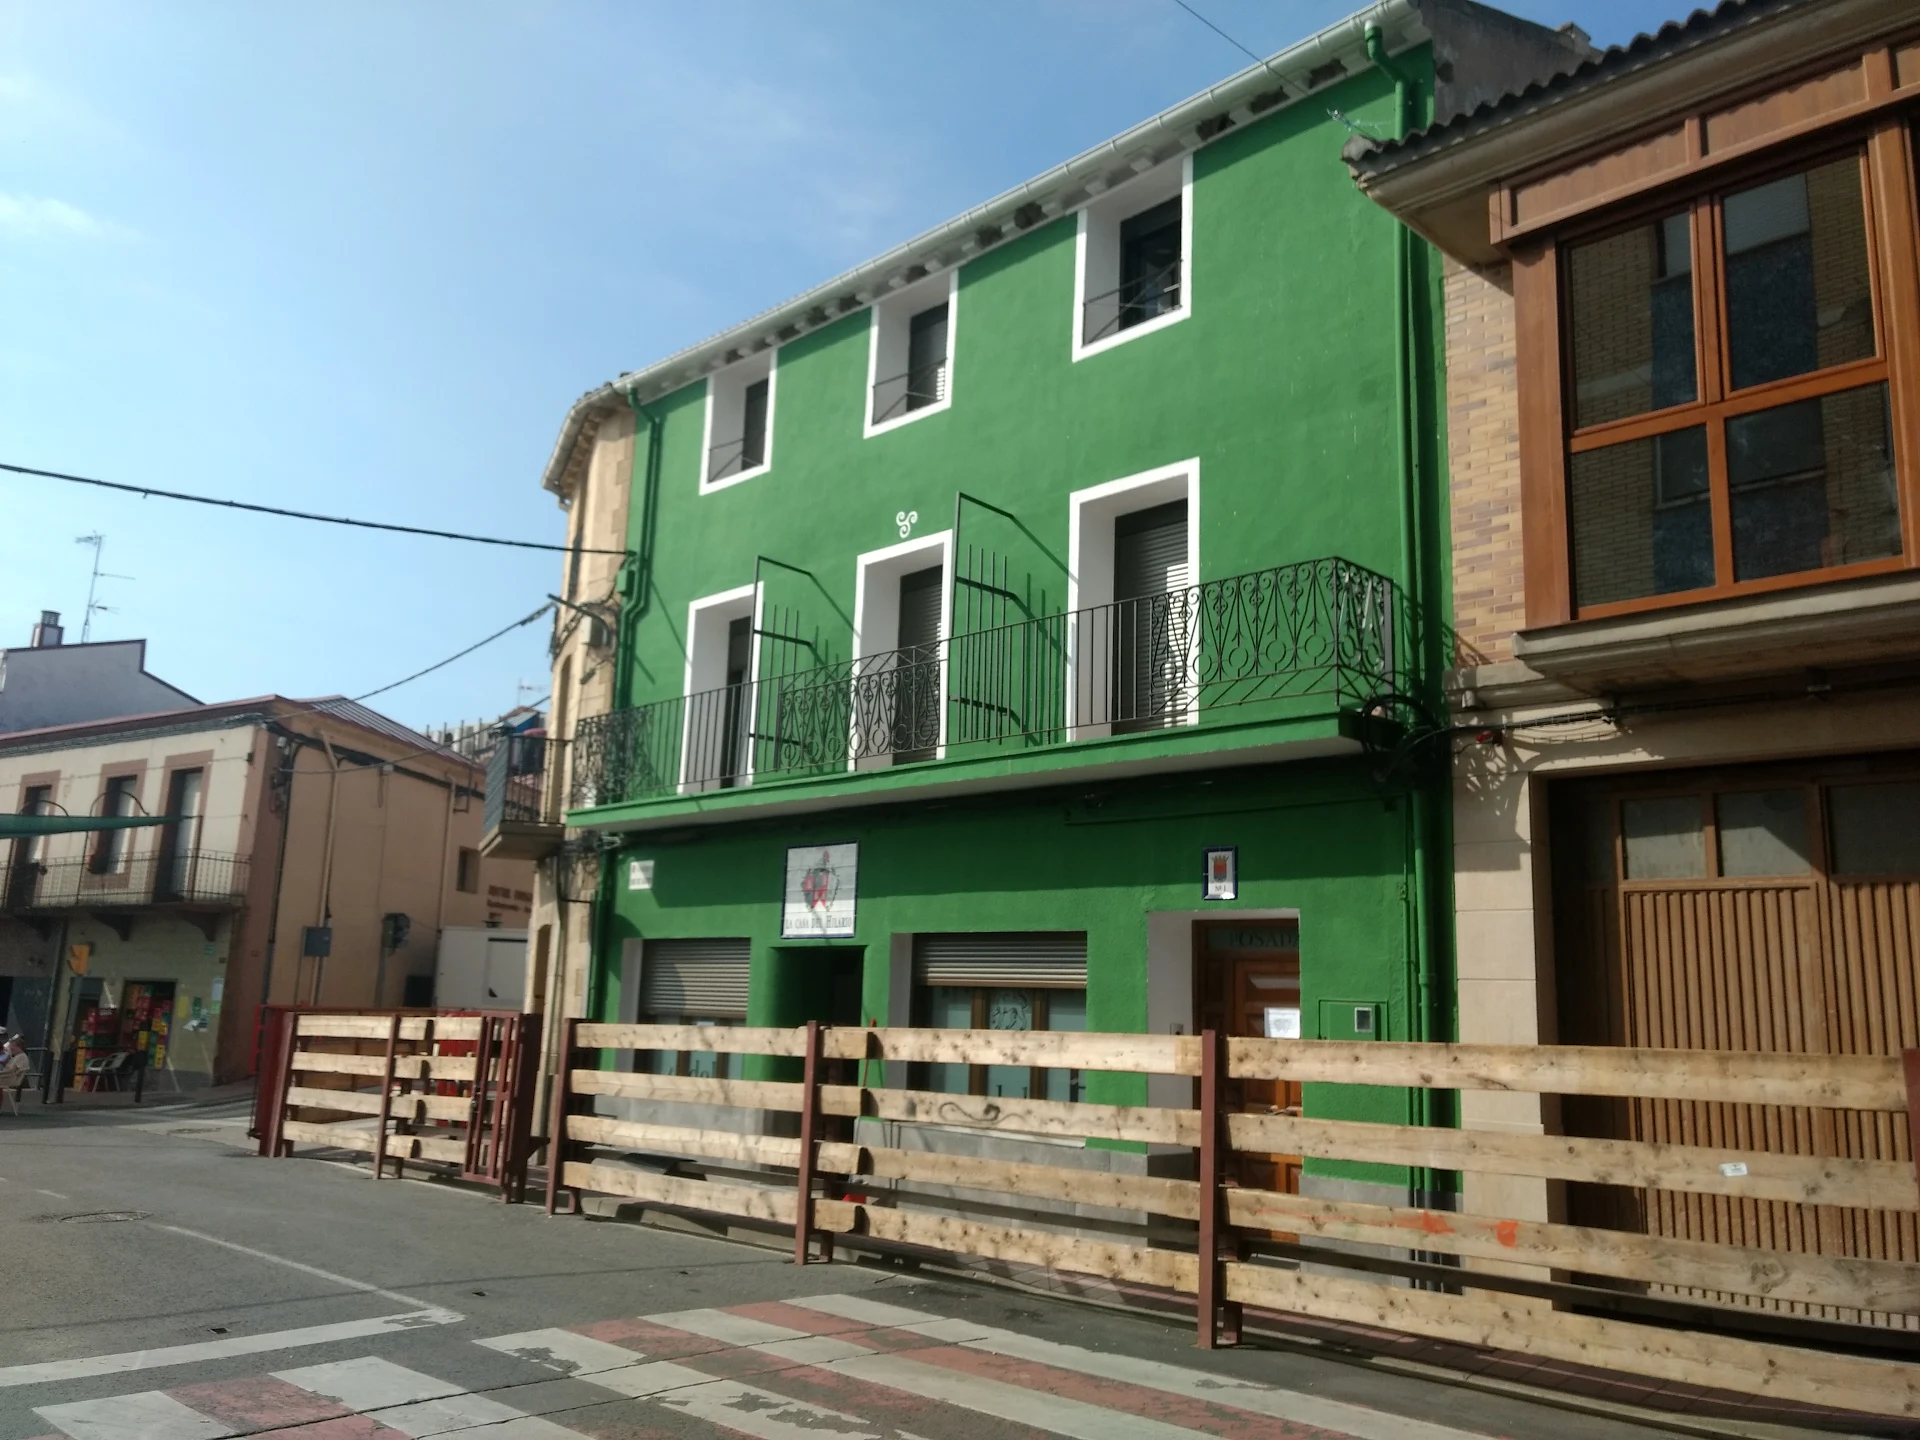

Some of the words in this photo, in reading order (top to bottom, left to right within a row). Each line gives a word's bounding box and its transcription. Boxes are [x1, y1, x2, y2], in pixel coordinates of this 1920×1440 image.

[795, 917, 810, 929] CASA
[811, 916, 823, 929] DEL
[826, 914, 853, 928] HILARIO
